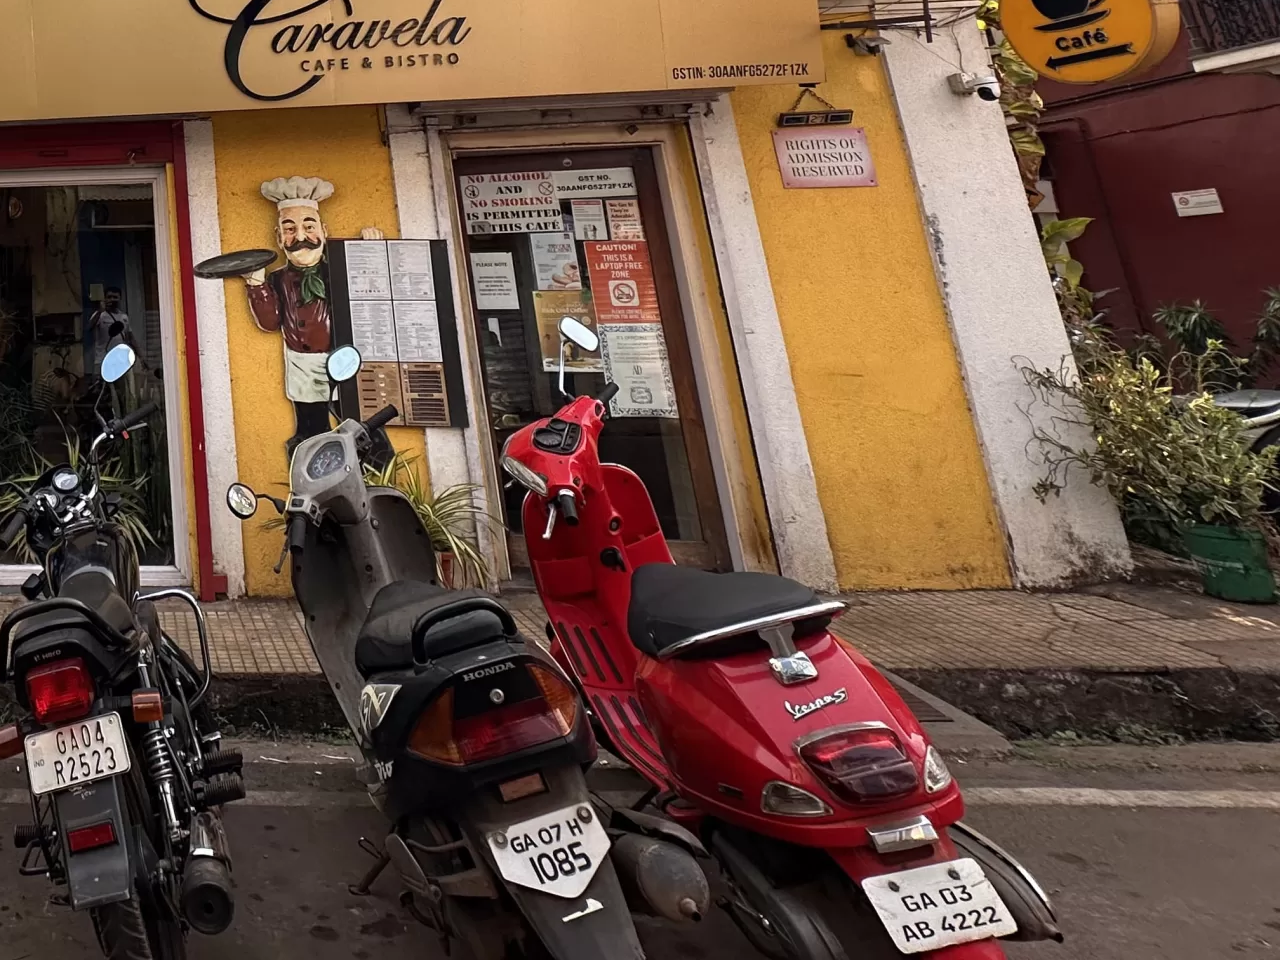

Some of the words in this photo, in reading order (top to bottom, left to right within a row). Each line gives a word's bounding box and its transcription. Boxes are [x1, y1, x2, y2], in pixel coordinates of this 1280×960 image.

[1055, 28, 1108, 51] Café
[300, 57, 349, 72] CAFE
[361, 57, 373, 69] &
[384, 52, 460, 68] BISTRO
[672, 66, 706, 80] GSTIN:
[810, 115, 825, 124] 27
[785, 139, 837, 150] RIGHTS
[839, 138, 857, 149] OF
[787, 152, 863, 164] ADMISSION
[467, 175, 484, 184] NO
[488, 172, 551, 184] ALCOHOL
[792, 165, 864, 177] RESERVED
[495, 186, 523, 195] AND
[470, 200, 487, 208] NO
[491, 197, 553, 207] SMOKING
[466, 212, 479, 221] IS
[483, 208, 561, 220] PERMITTED
[471, 224, 486, 233] IN
[489, 222, 522, 232] THIS
[526, 219, 561, 231] CAFÉ
[595, 262, 623, 270] LAPTOP
[624, 262, 643, 270] FREE
[611, 270, 630, 278] ZONE
[463, 661, 516, 682] HONDA
[55, 721, 105, 755] GA04
[54, 746, 117, 786] R2523
[510, 833, 538, 855] GA
[537, 823, 562, 845] 07
[566, 818, 584, 837] H
[529, 841, 592, 885] 1085
[900, 892, 938, 913] GA
[939, 884, 974, 906] 03
[901, 920, 935, 943] AB
[940, 905, 1003, 933] 4222
